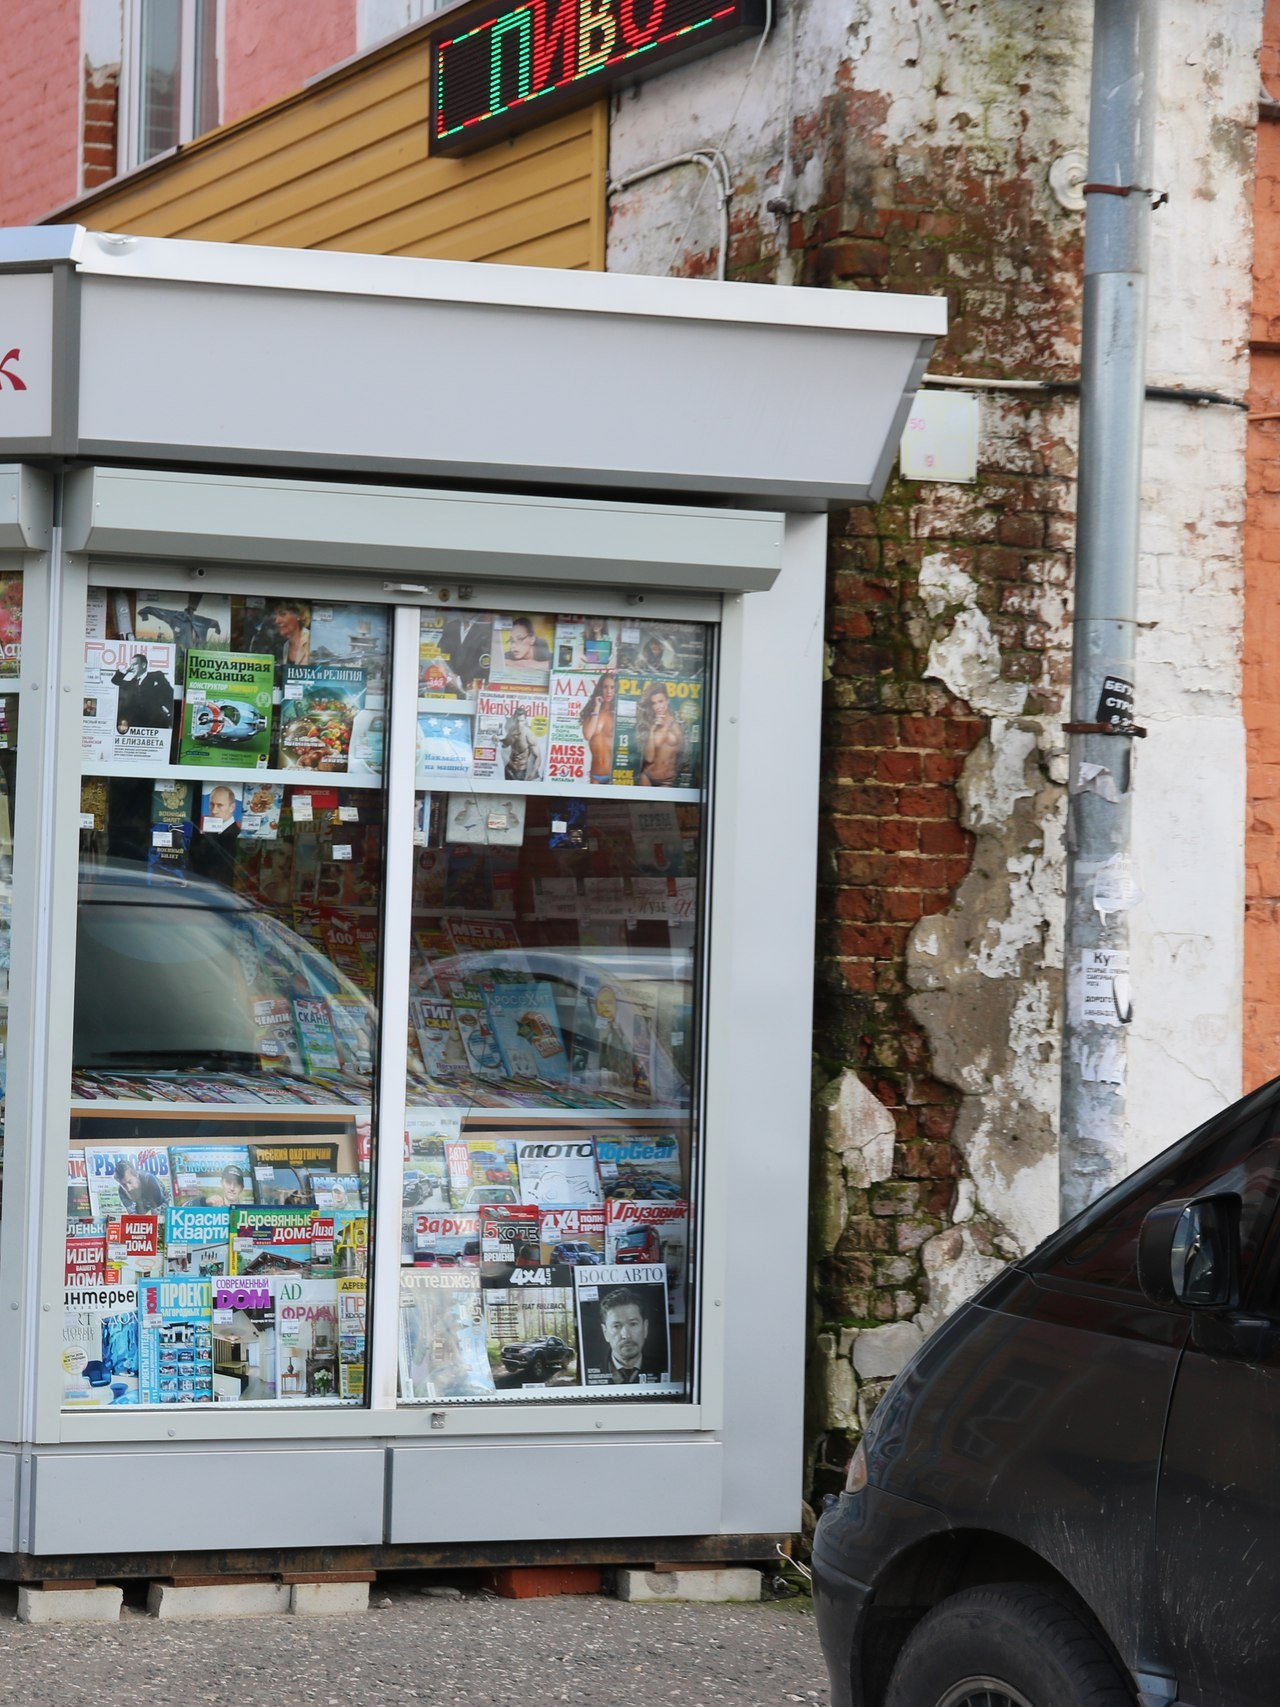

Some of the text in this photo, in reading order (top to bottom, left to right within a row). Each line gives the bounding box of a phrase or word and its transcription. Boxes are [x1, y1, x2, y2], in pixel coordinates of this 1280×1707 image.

[189, 655, 272, 673] Популярная
[188, 667, 255, 683] Механика
[287, 668, 316, 679] НАУКА
[323, 669, 362, 681] РЕЛИГИЯ
[129, 728, 159, 737] МАСТЕР
[121, 738, 164, 747] ЕЛИЗАВЕТА
[550, 745, 585, 757] MISS
[550, 756, 584, 765] MAXIM
[449, 1147, 467, 1161] АВТО
[449, 1160, 469, 1176] МИР
[171, 1209, 230, 1230] Красив
[125, 1223, 153, 1235] ИДЕИ
[172, 1225, 229, 1244] кварти
[311, 1222, 334, 1237] Лиза
[67, 1248, 104, 1264] ИДЕИ
[484, 1252, 515, 1262] ВРЕМЕНИ
[67, 1271, 104, 1287] ДОМА
[579, 1267, 663, 1283] БОСС АВТО
[216, 1277, 269, 1289] СОВРЕМЕННЫЙ
[280, 1283, 302, 1300] AD
[141, 1328, 150, 1357] КОТТЕДЖ
